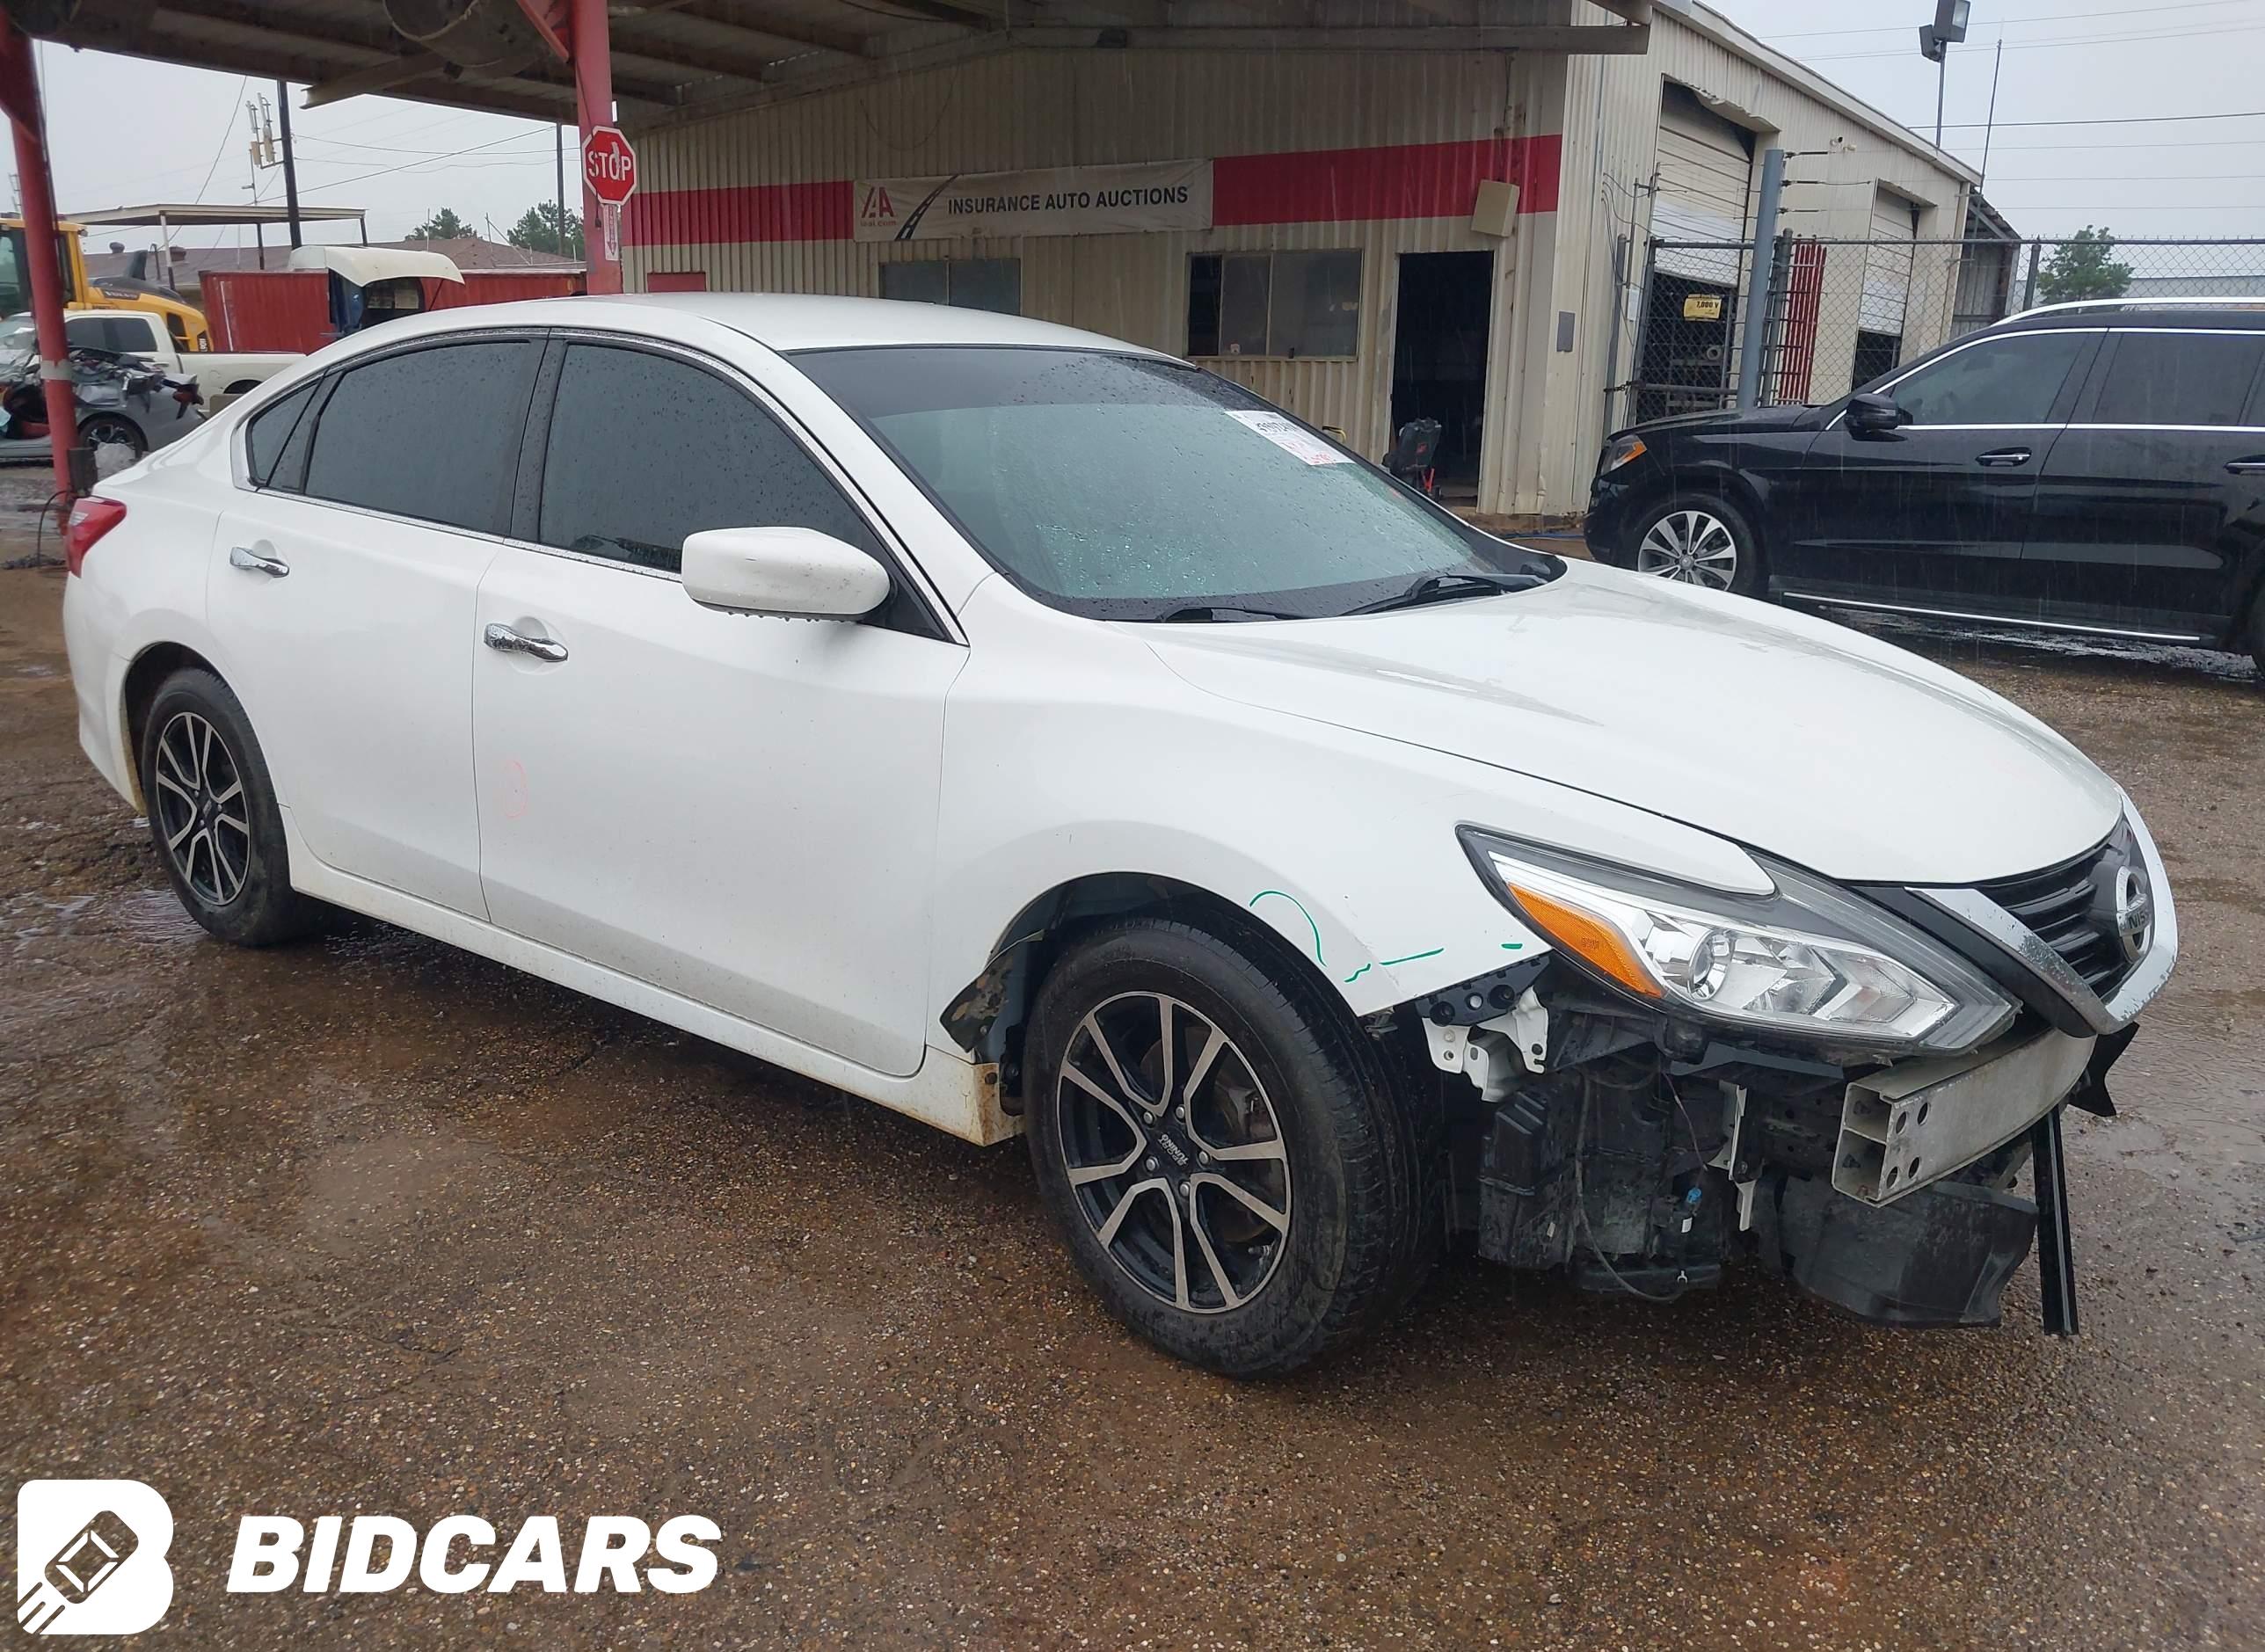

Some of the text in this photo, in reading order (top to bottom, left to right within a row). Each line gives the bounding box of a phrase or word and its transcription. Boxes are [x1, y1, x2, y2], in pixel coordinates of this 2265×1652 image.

[587, 150, 631, 181] STOP
[948, 186, 1188, 215] INSURANCE AUTO AUCTIONS
